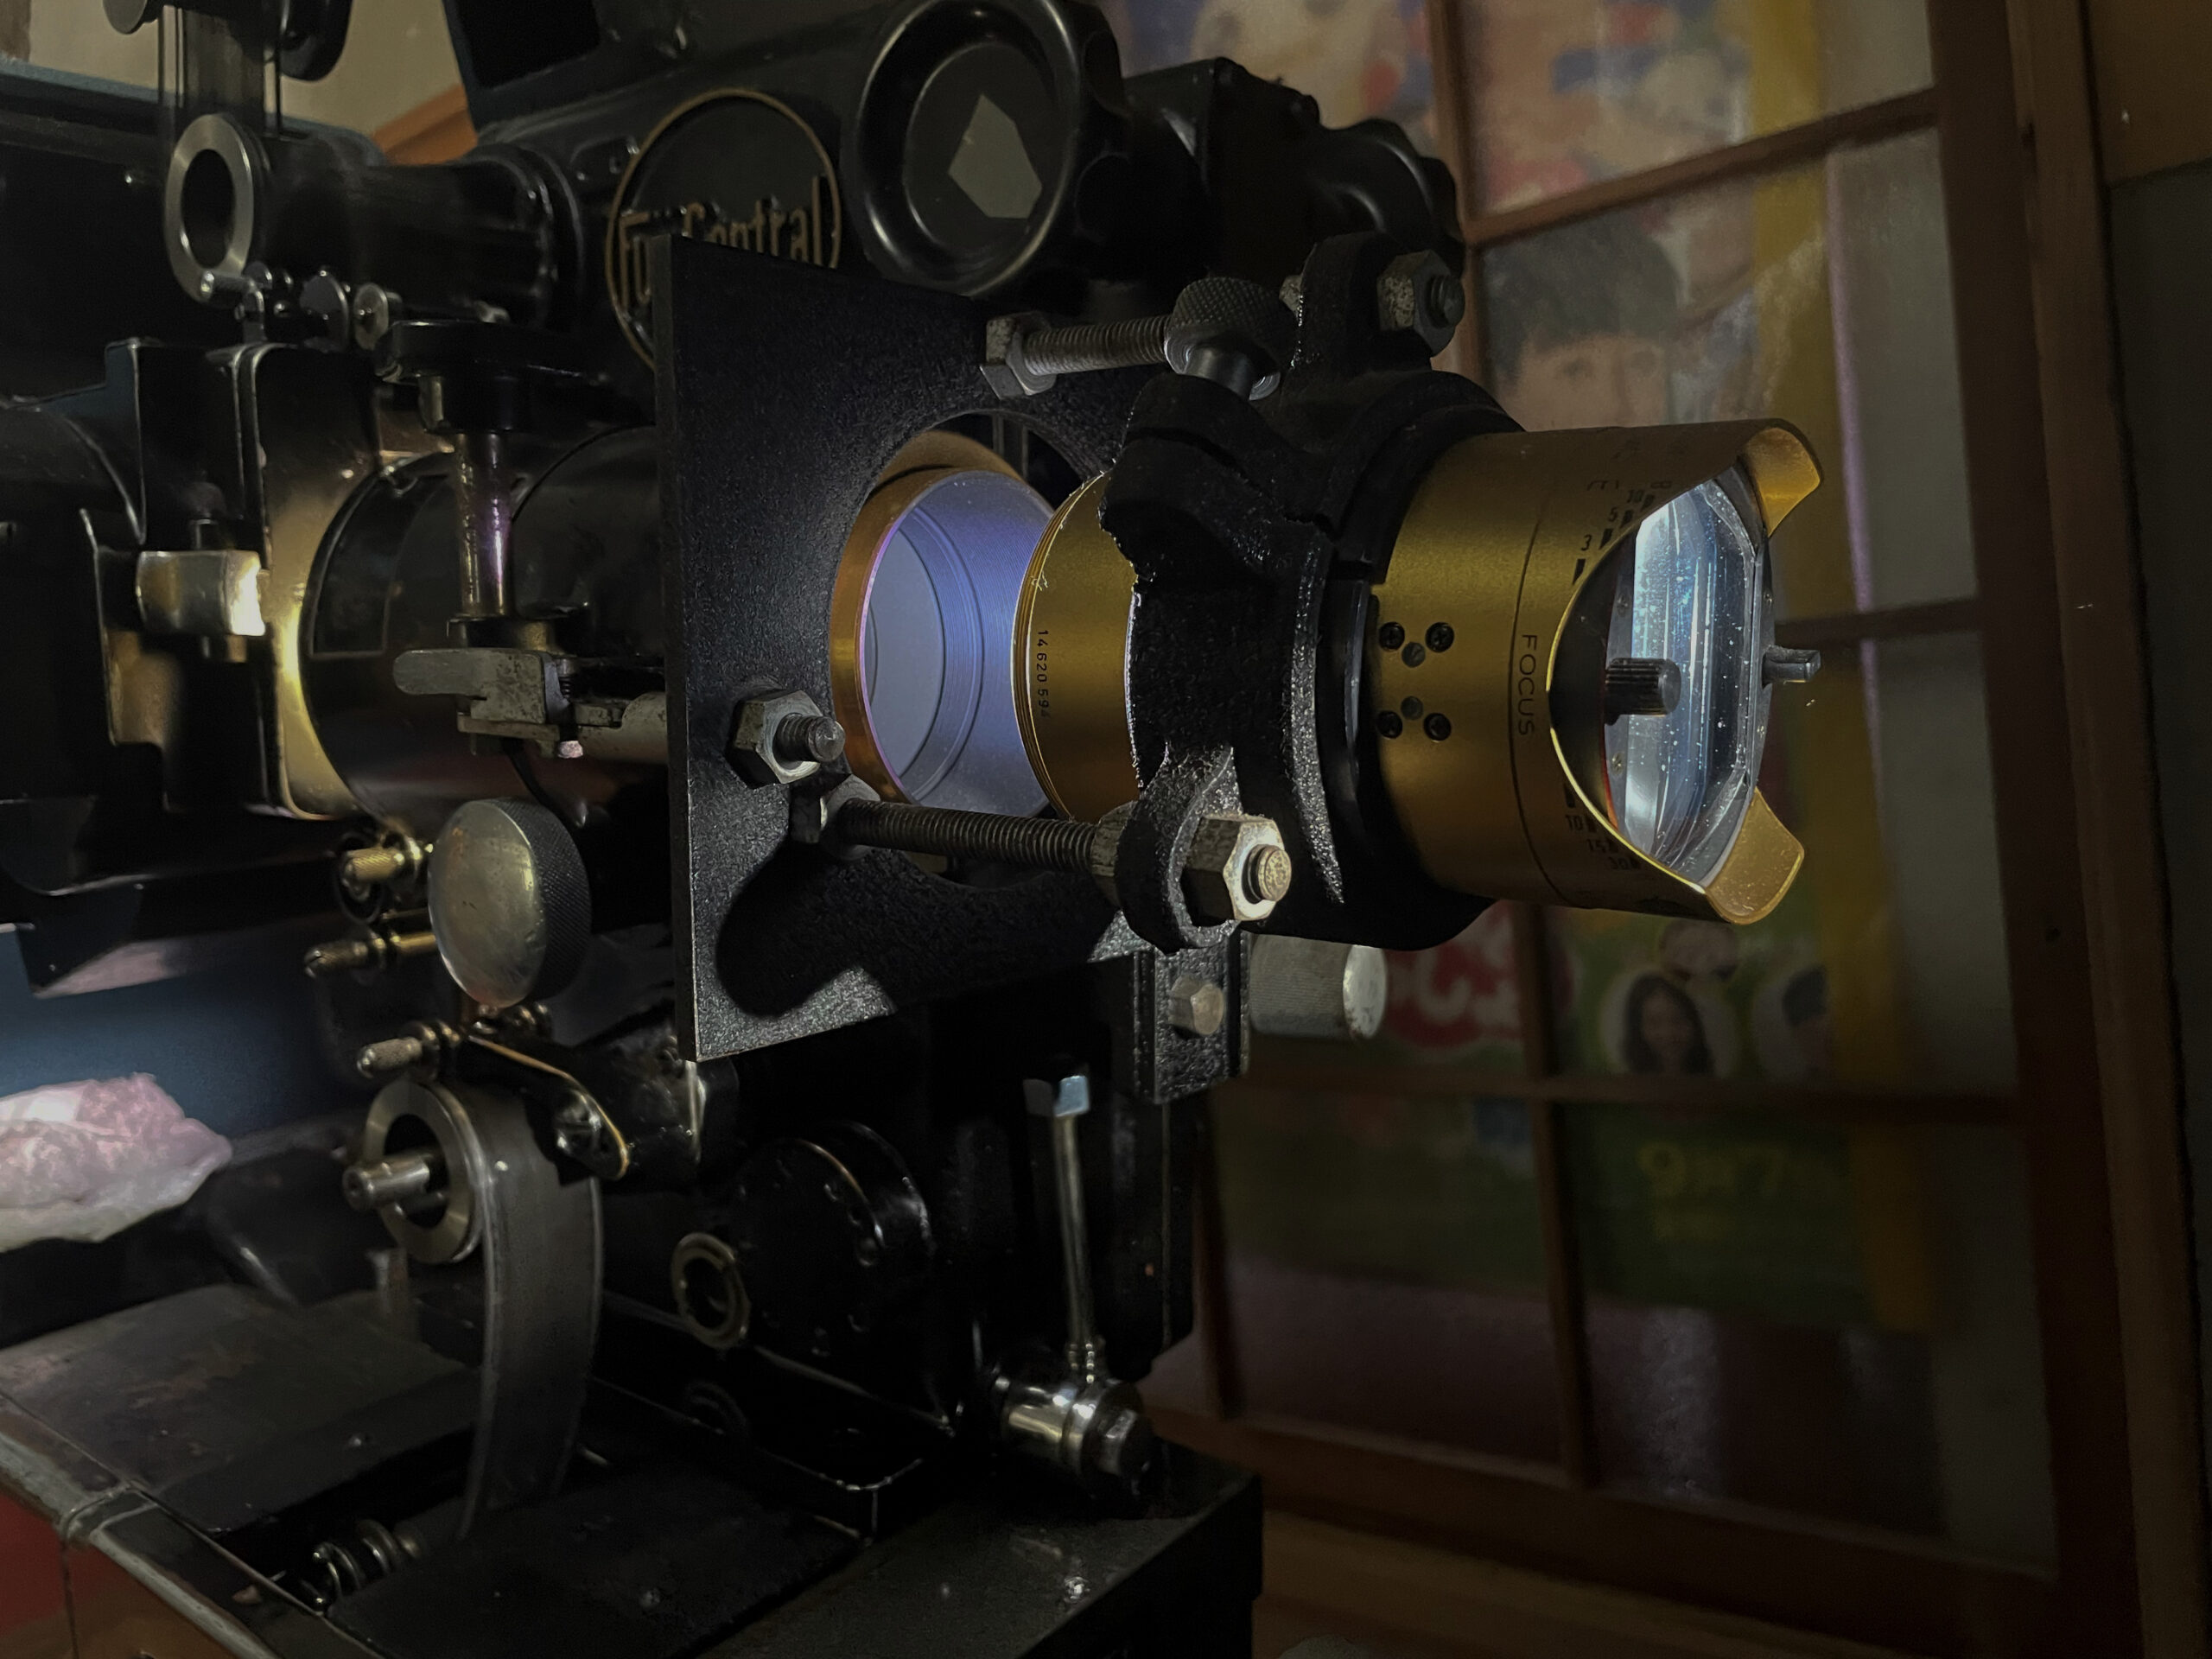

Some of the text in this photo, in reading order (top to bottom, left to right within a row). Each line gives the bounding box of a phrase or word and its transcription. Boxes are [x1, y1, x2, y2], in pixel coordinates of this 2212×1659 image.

[1580, 534, 1592, 551] 3
[1608, 507, 1618, 522] 5
[1517, 634, 1538, 736] FOCUS
